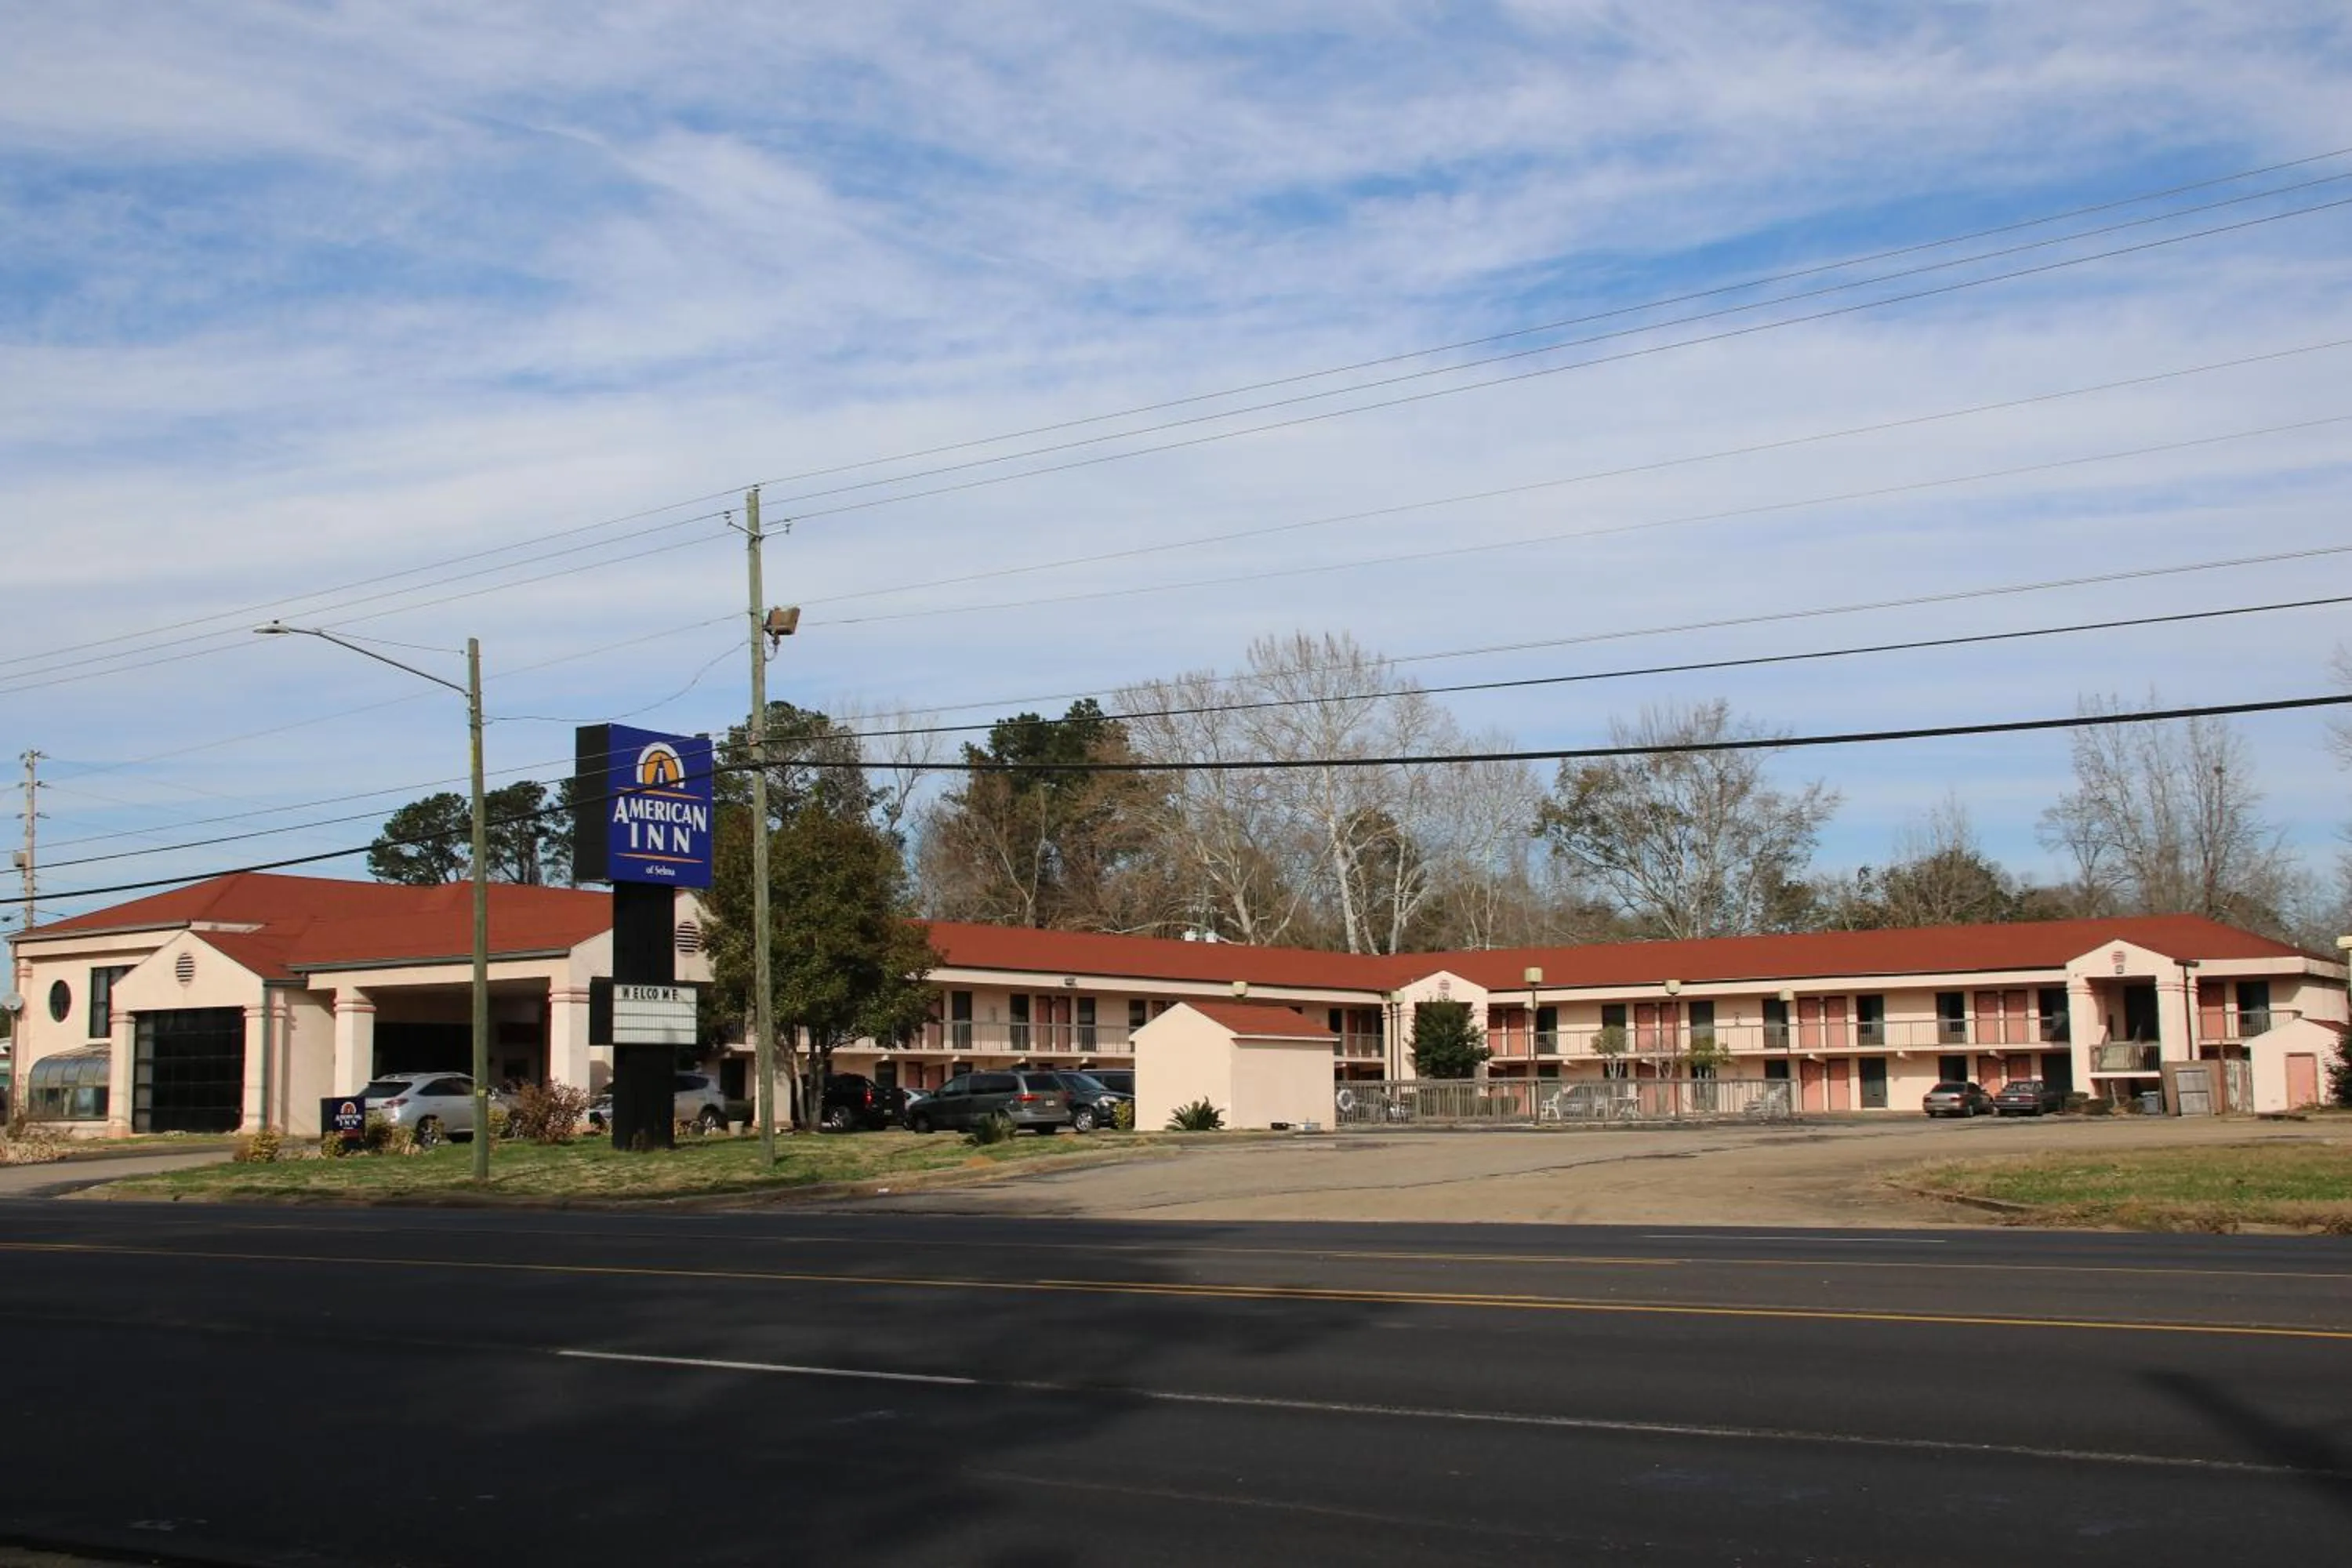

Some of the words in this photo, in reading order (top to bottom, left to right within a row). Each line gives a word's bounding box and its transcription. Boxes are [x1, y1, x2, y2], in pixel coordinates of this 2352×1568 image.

[613, 796, 706, 833] AMERICAN
[630, 822, 690, 854] INN
[645, 865, 655, 874] of
